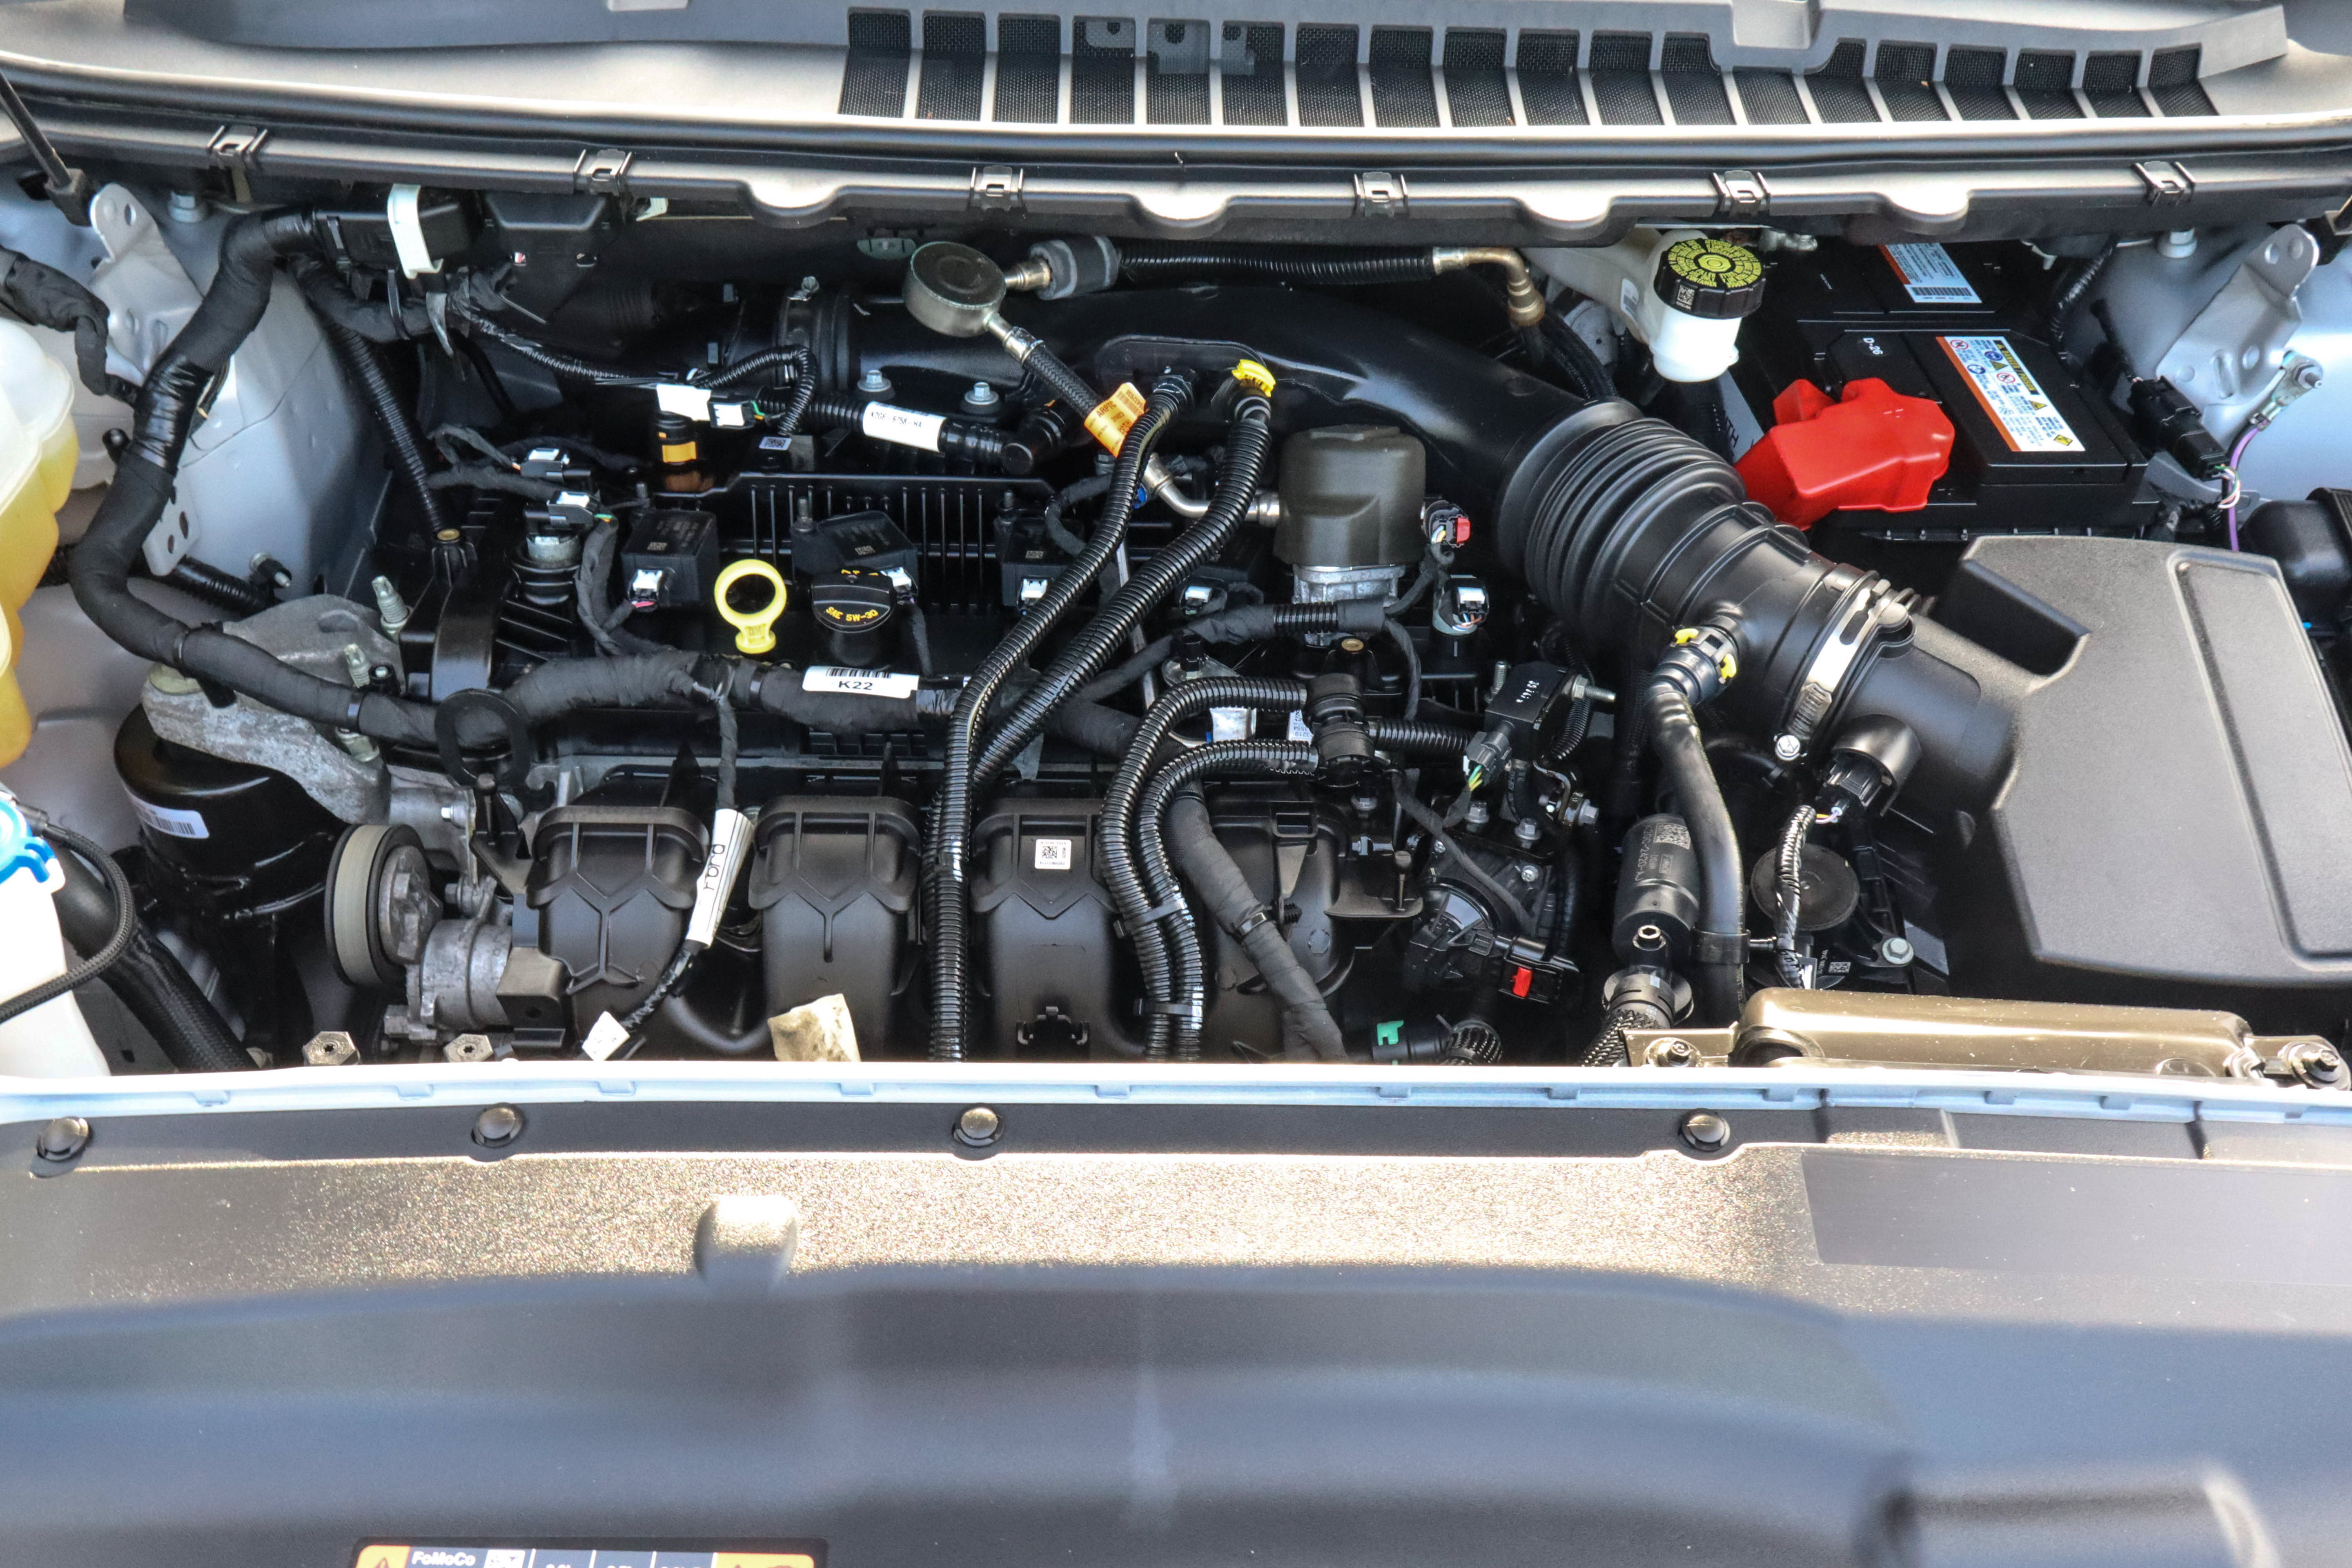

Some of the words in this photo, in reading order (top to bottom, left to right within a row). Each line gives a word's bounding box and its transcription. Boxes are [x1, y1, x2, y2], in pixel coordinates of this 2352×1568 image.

[1863, 338, 1883, 355] D-26
[1096, 401, 1117, 418] ARPTC
[825, 606, 843, 620] SAE
[846, 609, 879, 621] 5W-30
[838, 681, 873, 690] K22
[411, 1550, 476, 1566] FoMoCo
